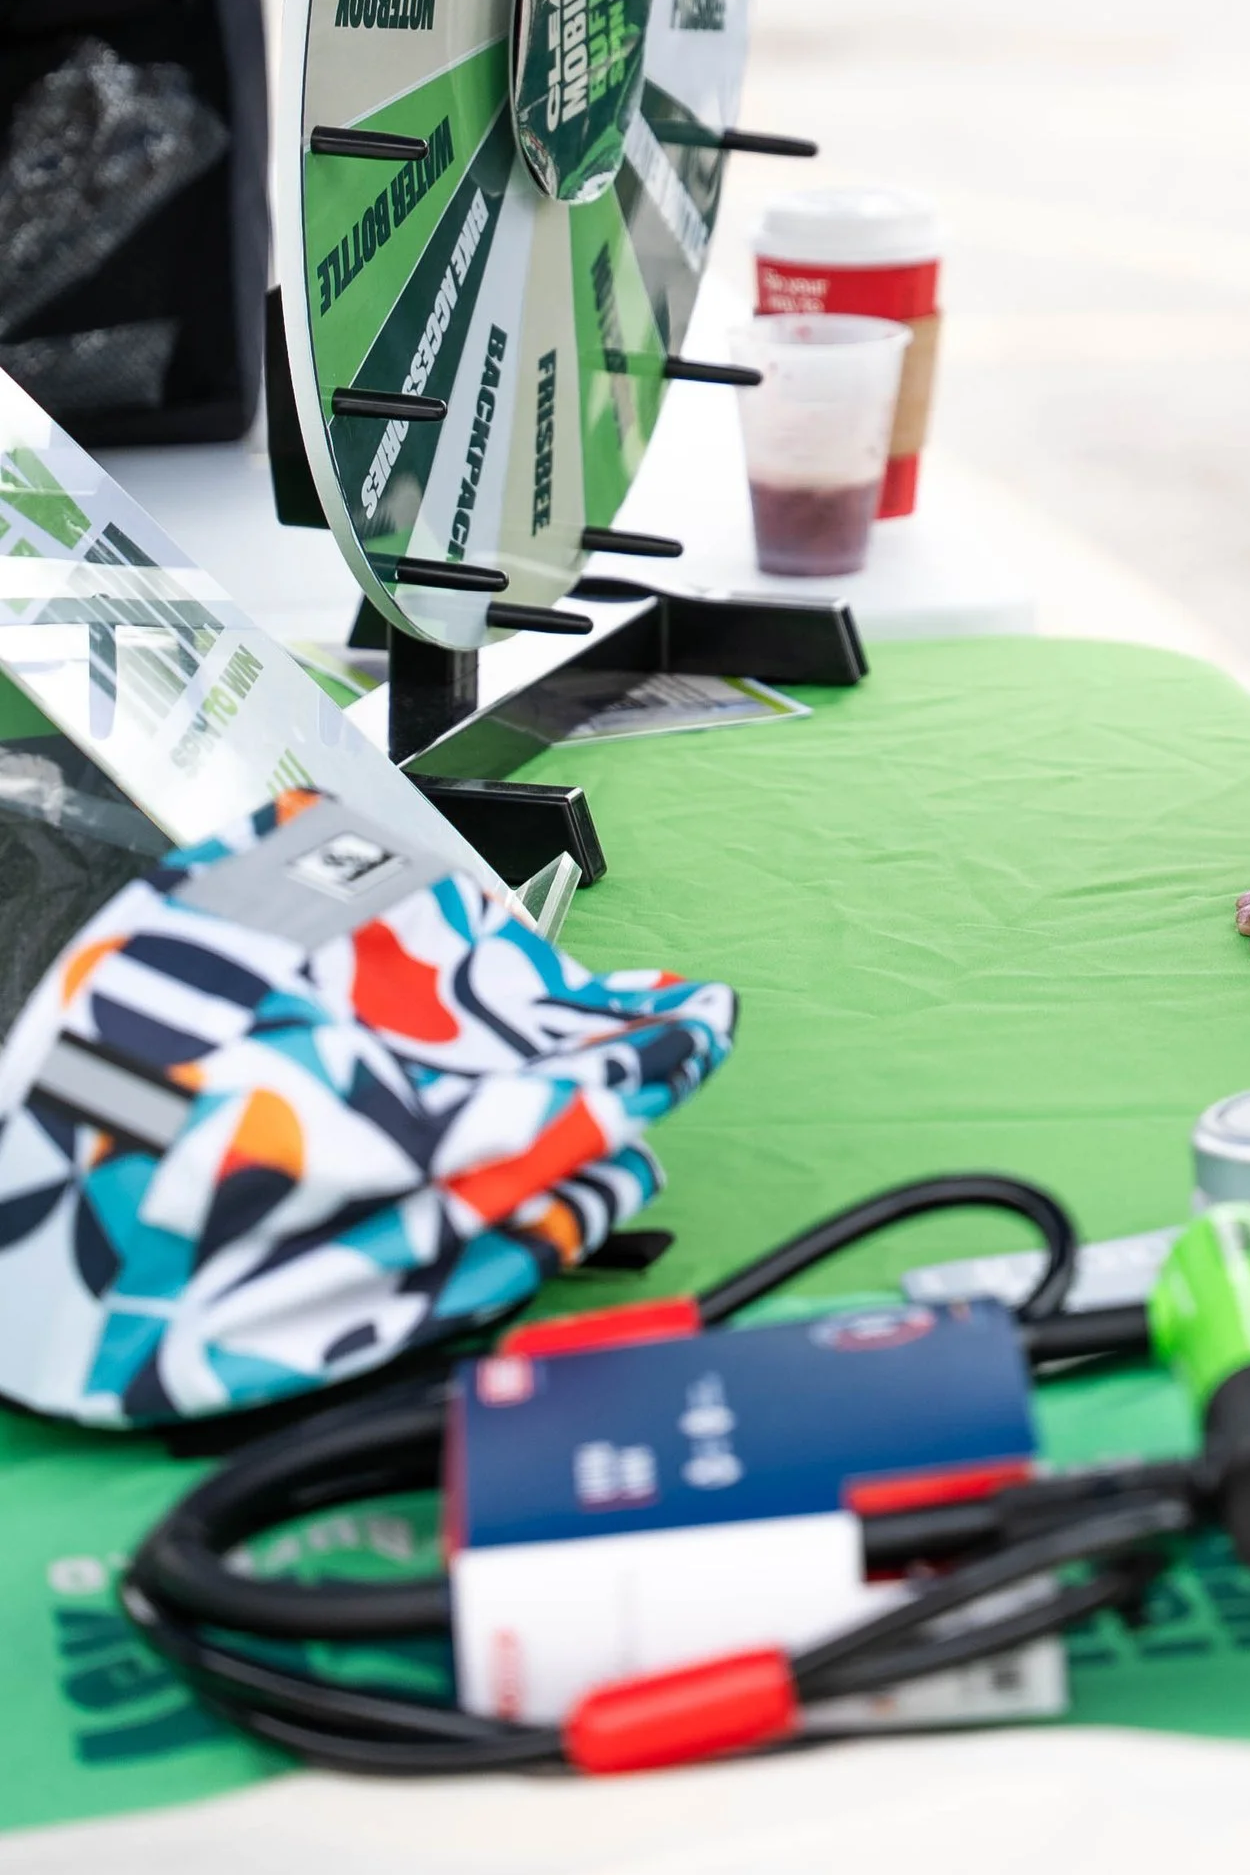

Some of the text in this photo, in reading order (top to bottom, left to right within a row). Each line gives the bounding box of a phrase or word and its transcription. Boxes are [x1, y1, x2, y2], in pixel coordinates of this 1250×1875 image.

[317, 115, 454, 318] WATER BOTTLE
[450, 186, 489, 287] BIKE
[531, 348, 557, 538] FRISBEE
[203, 685, 239, 726] TO
[222, 643, 264, 701] WIN
